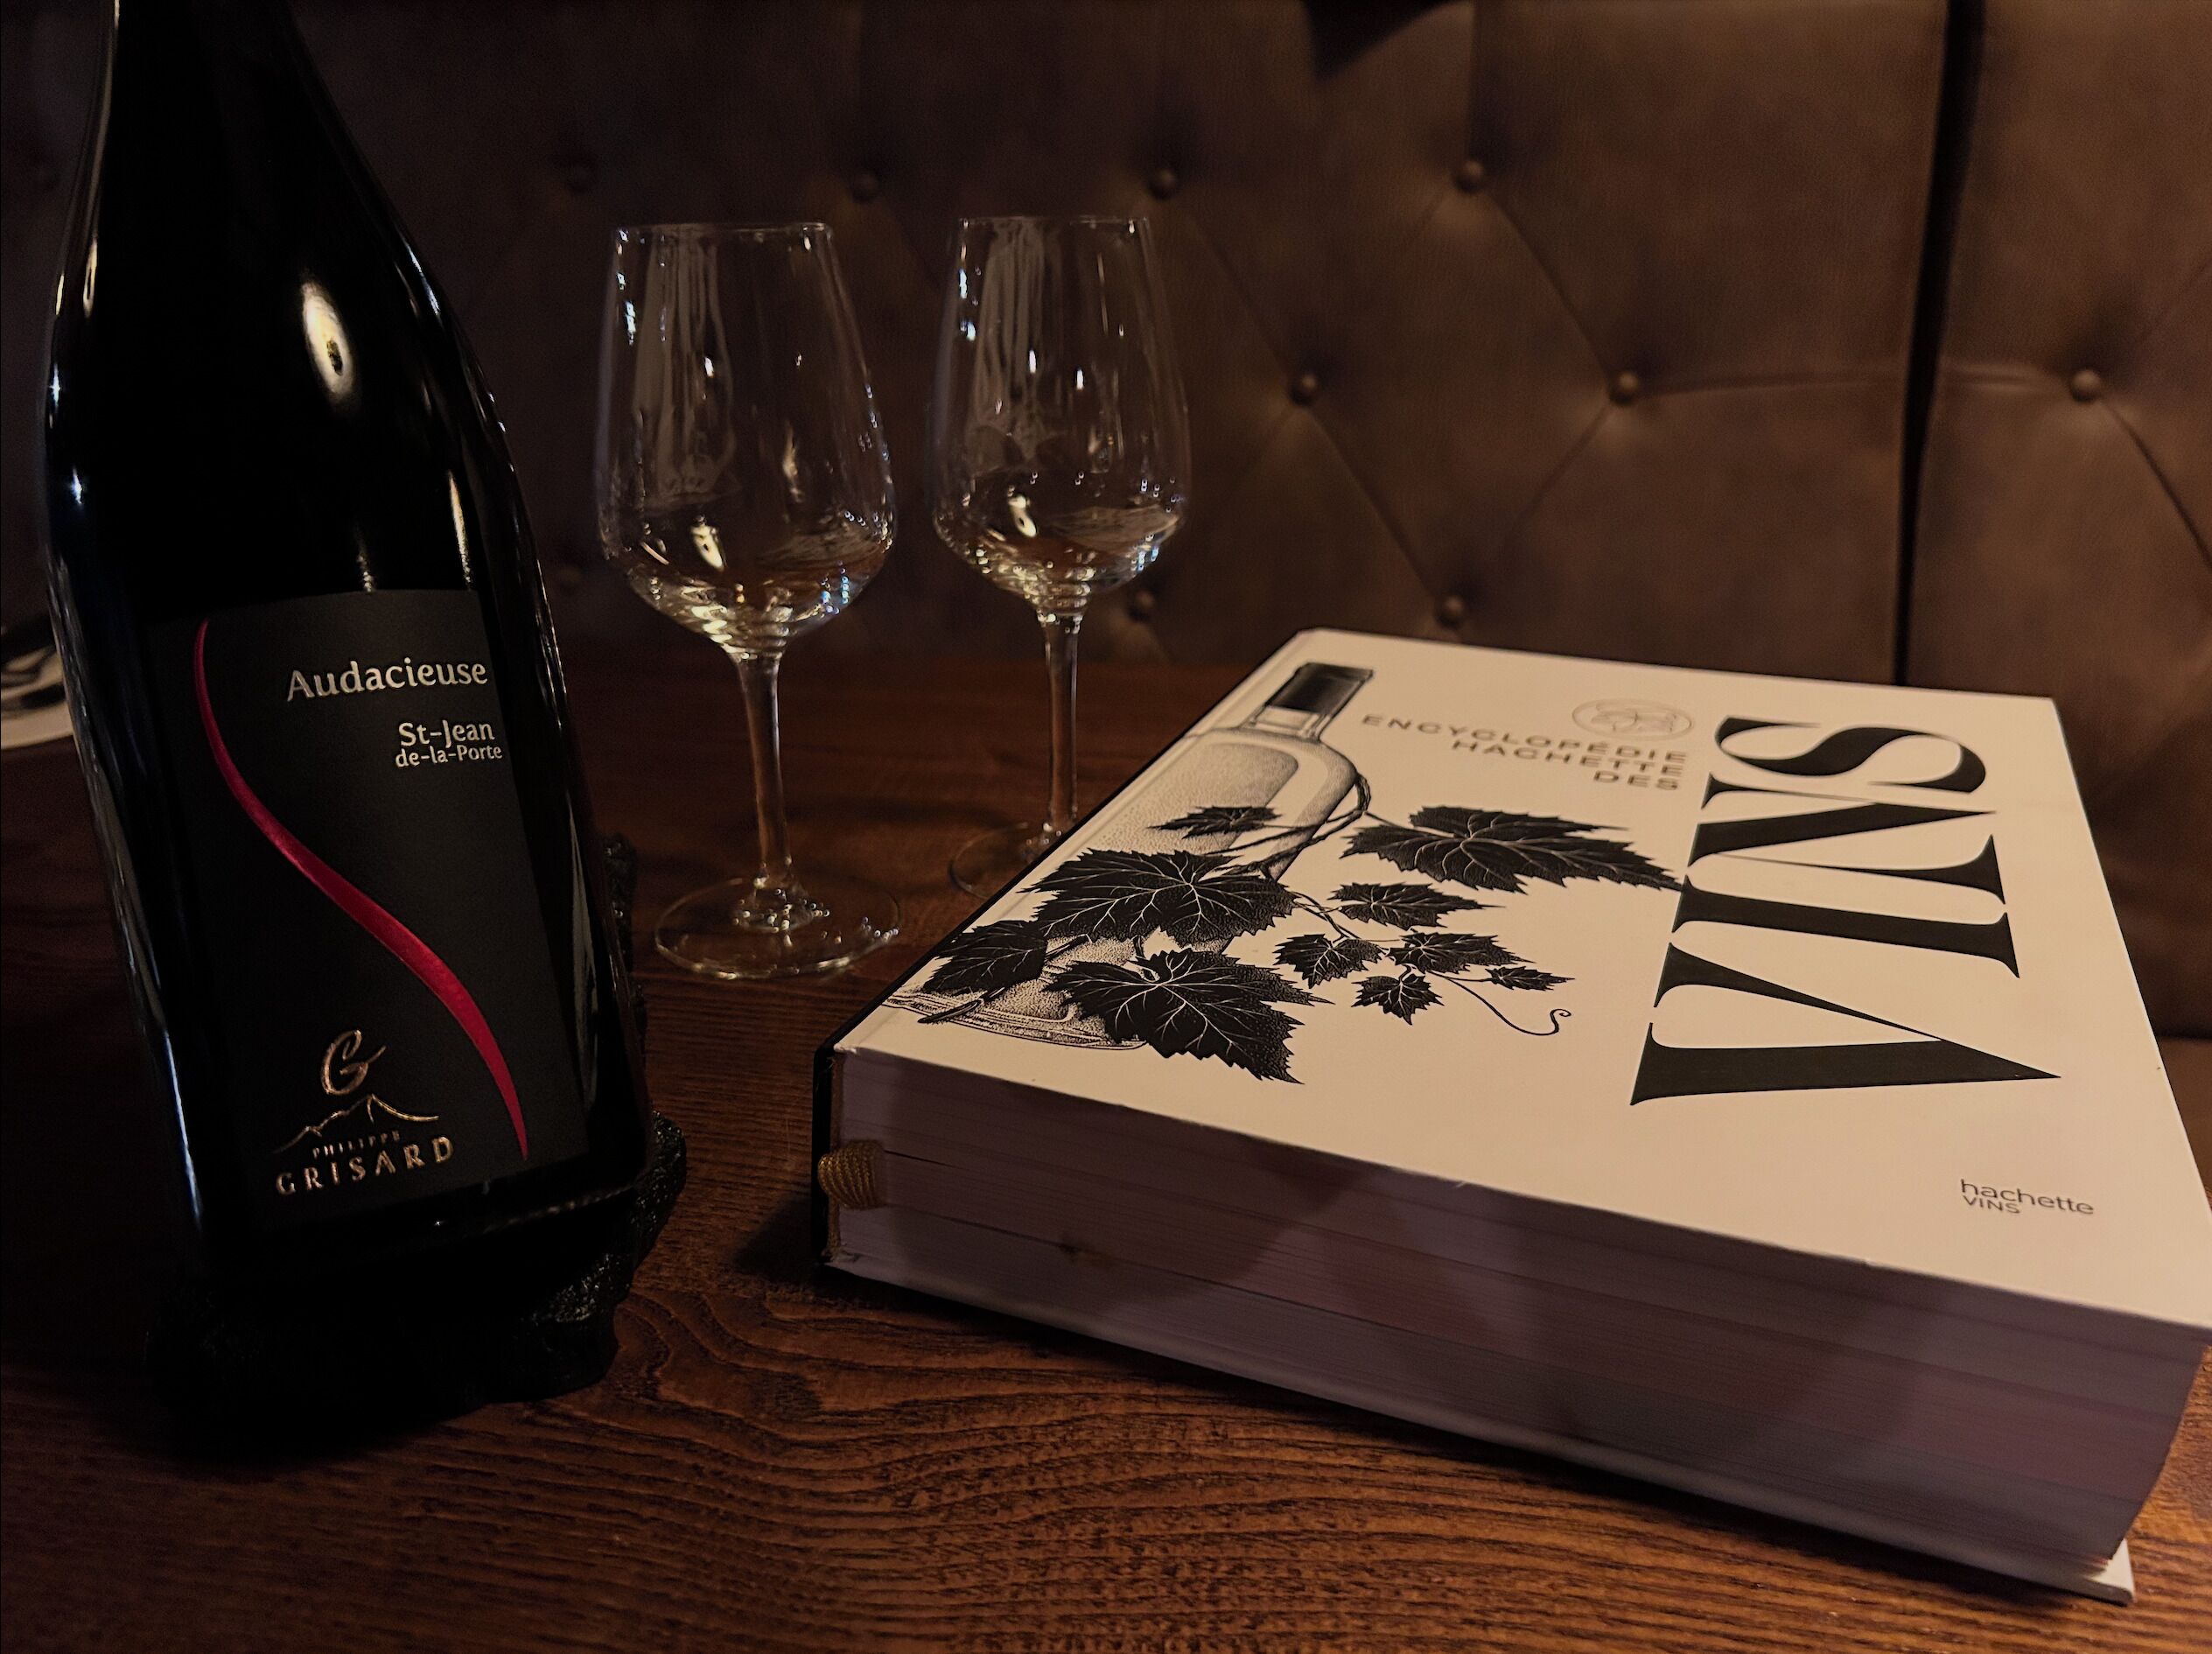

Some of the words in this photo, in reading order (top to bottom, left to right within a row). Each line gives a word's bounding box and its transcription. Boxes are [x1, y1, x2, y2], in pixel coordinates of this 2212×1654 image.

[286, 656, 488, 702] Audacieuse
[397, 718, 495, 748] St-Jean
[1361, 713, 1688, 764] ENCYCLOPÉDIE
[395, 744, 503, 768] de-la-Porte
[1451, 739, 1684, 776] HACHETTE
[1592, 769, 1679, 791] DES
[1631, 717, 2062, 1105] VINS
[275, 1135, 454, 1196] GRISARD
[1960, 1179, 2094, 1215] hachette
[1963, 1195, 2020, 1215] VINS
